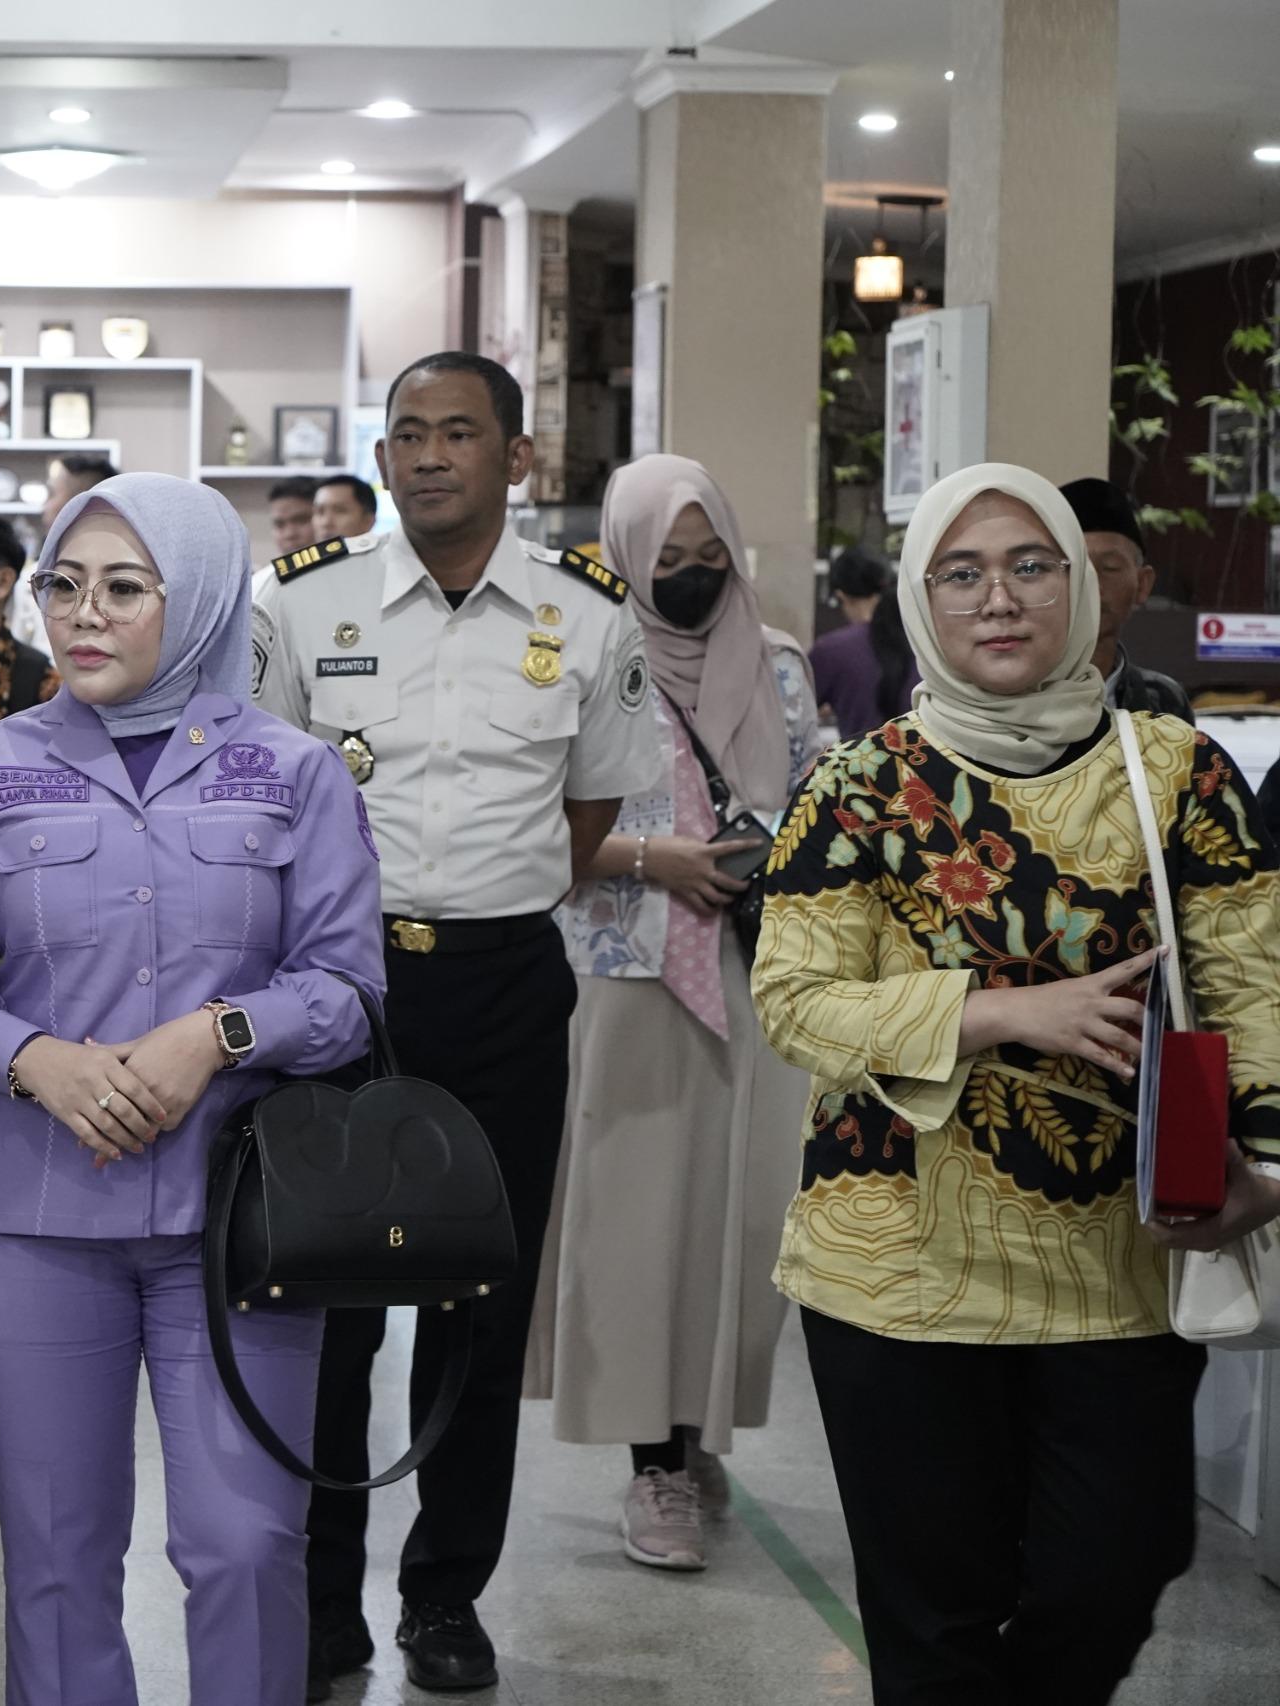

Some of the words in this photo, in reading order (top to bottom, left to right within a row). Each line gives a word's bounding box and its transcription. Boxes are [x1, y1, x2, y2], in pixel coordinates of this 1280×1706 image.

[321, 660, 365, 672] YULIANTO
[366, 660, 374, 671] B
[40, 788, 71, 800] RINA
[213, 784, 283, 801] DPD-RI
